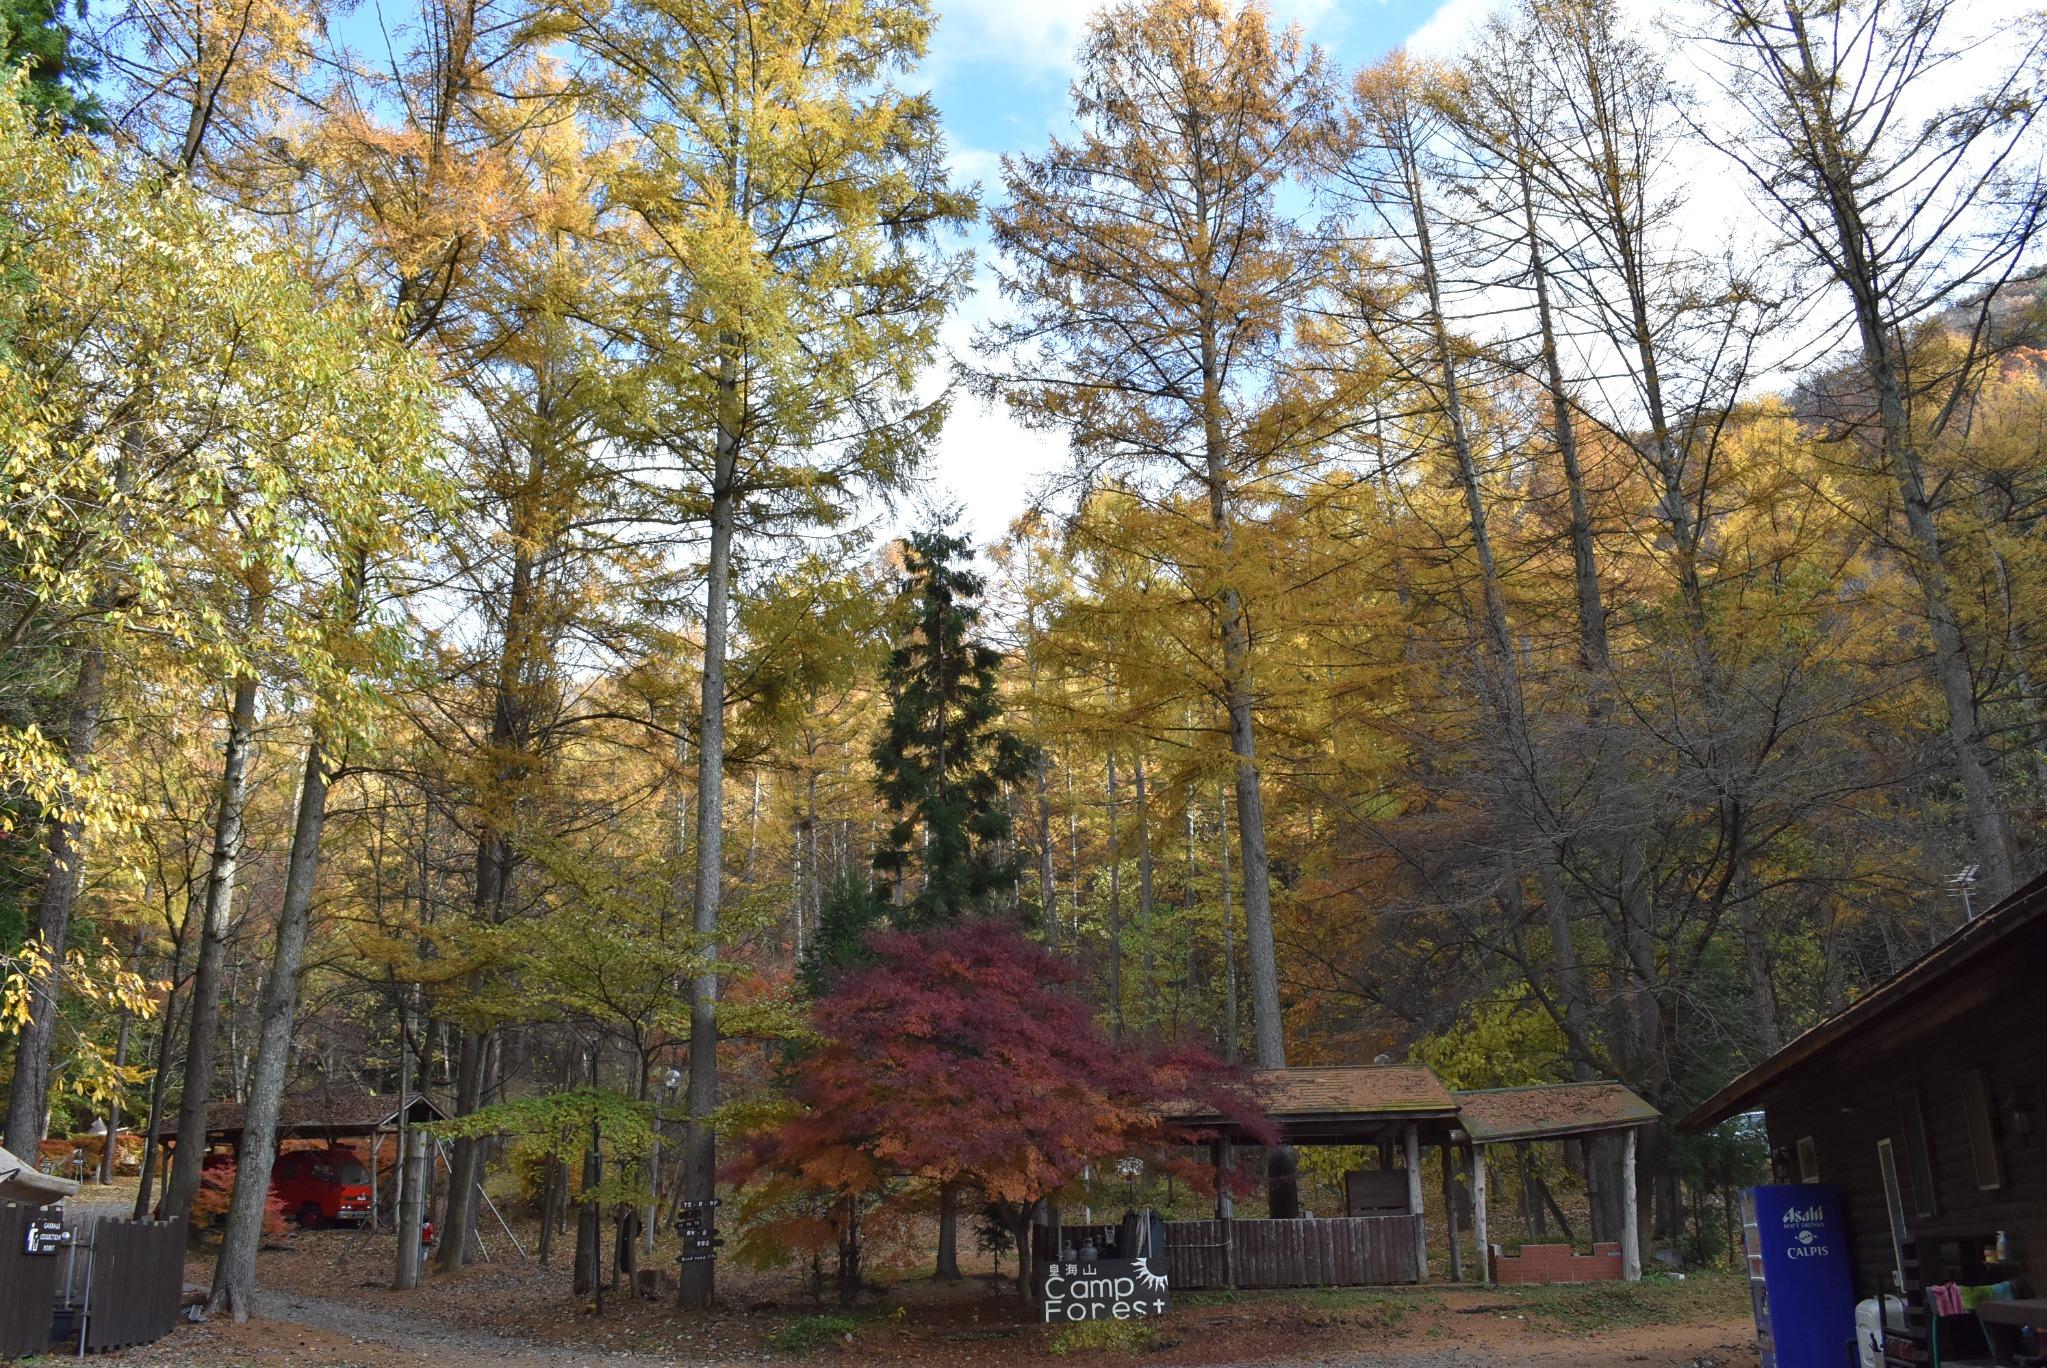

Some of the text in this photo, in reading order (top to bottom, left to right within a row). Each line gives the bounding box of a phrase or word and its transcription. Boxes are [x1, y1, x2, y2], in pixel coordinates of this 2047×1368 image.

[1783, 1205, 1824, 1223] Asahi
[1787, 1246, 1829, 1259] CALPIS
[1049, 1264, 1097, 1276] 皇海山
[1045, 1277, 1134, 1301] Camp
[1045, 1299, 1165, 1323] Forest
